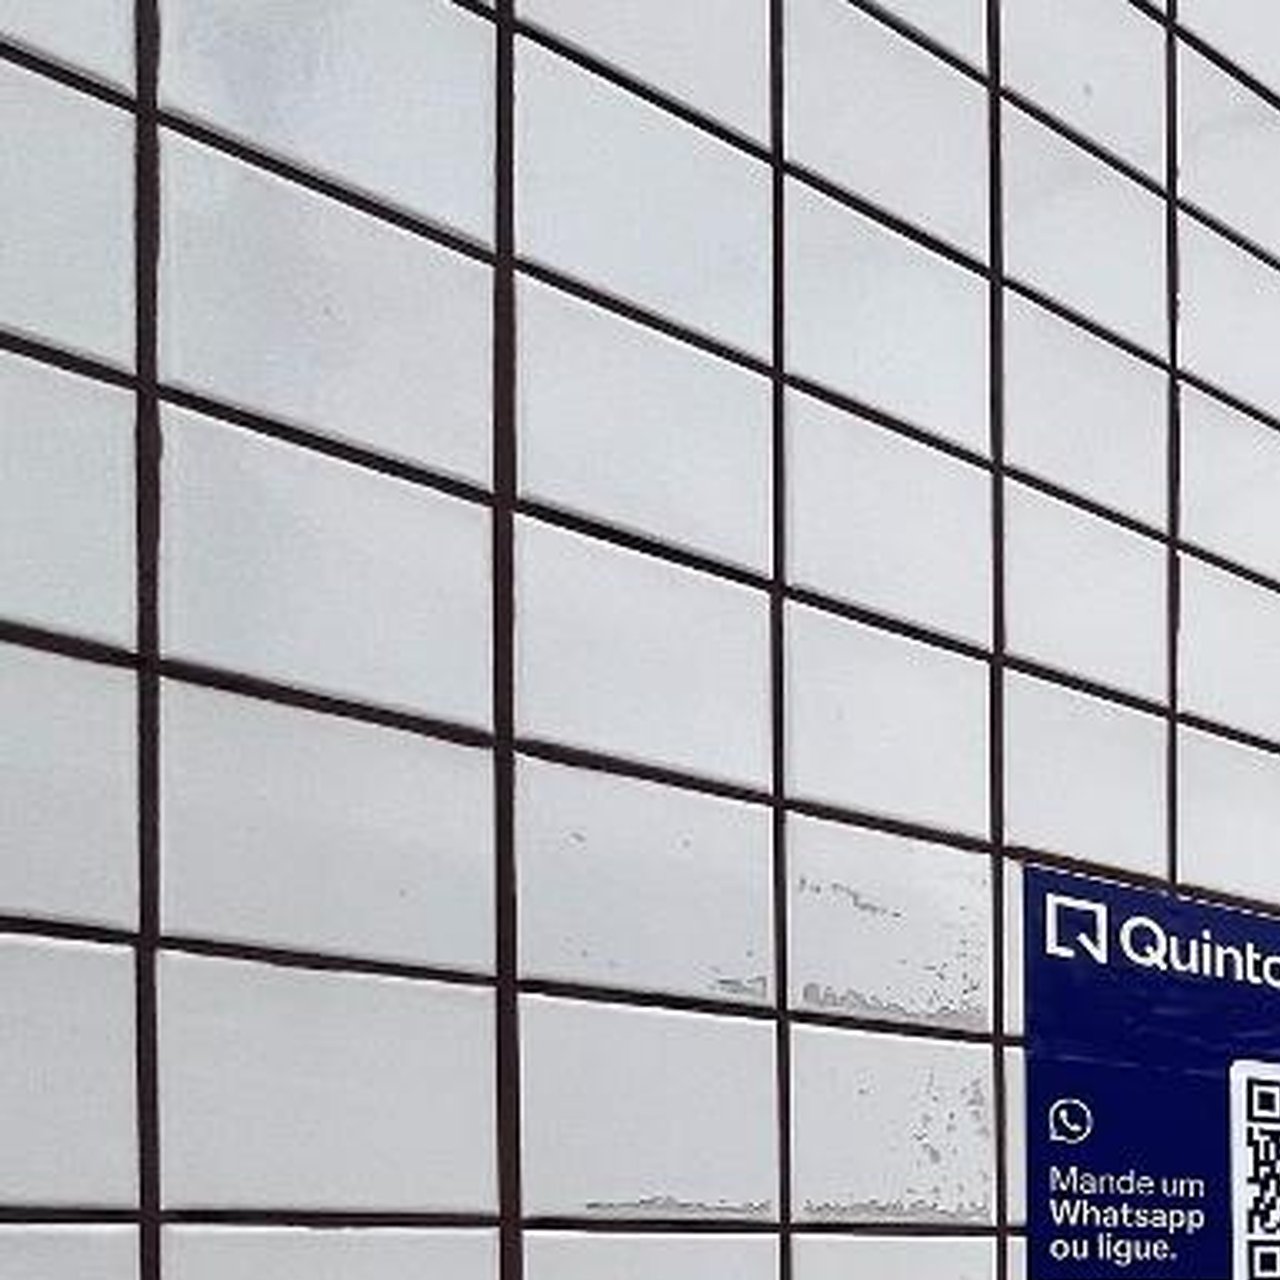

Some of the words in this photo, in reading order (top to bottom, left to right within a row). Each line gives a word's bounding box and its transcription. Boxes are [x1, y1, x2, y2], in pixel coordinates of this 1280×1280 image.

[1049, 1165, 1155, 1196] Mande
[1161, 1178, 1205, 1198] um
[1049, 1198, 1205, 1235] Whatsapp
[1049, 1239, 1089, 1261] ou
[1097, 1232, 1178, 1267] ligue.
